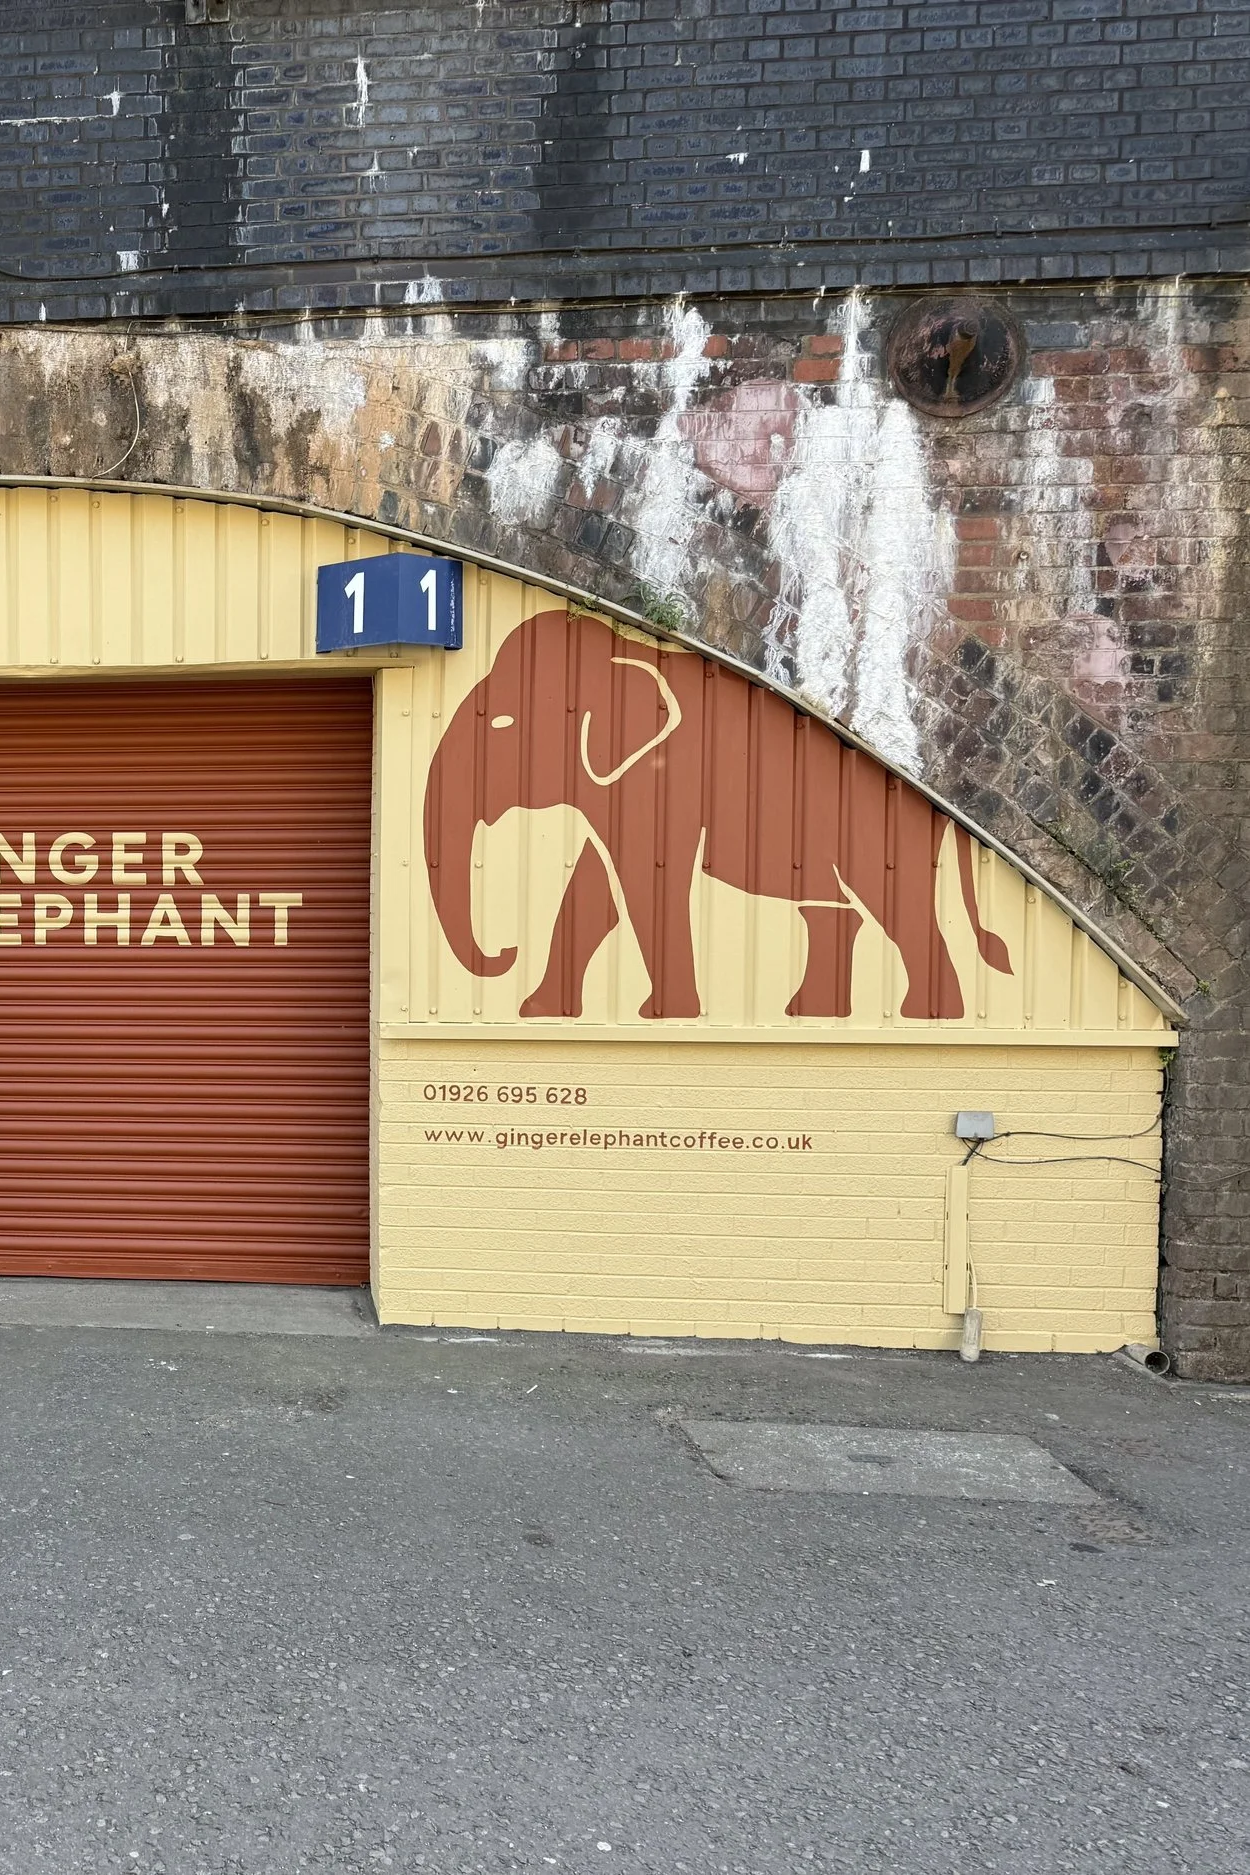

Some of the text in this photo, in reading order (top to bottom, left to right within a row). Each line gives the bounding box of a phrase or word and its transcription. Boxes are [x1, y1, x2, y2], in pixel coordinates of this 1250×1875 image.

[344, 571, 365, 634] 1
[420, 569, 437, 631] 1
[423, 1084, 588, 1105] 01926 695 628
[424, 1127, 813, 1151] www.gingerelephantcoffee.co.uk
